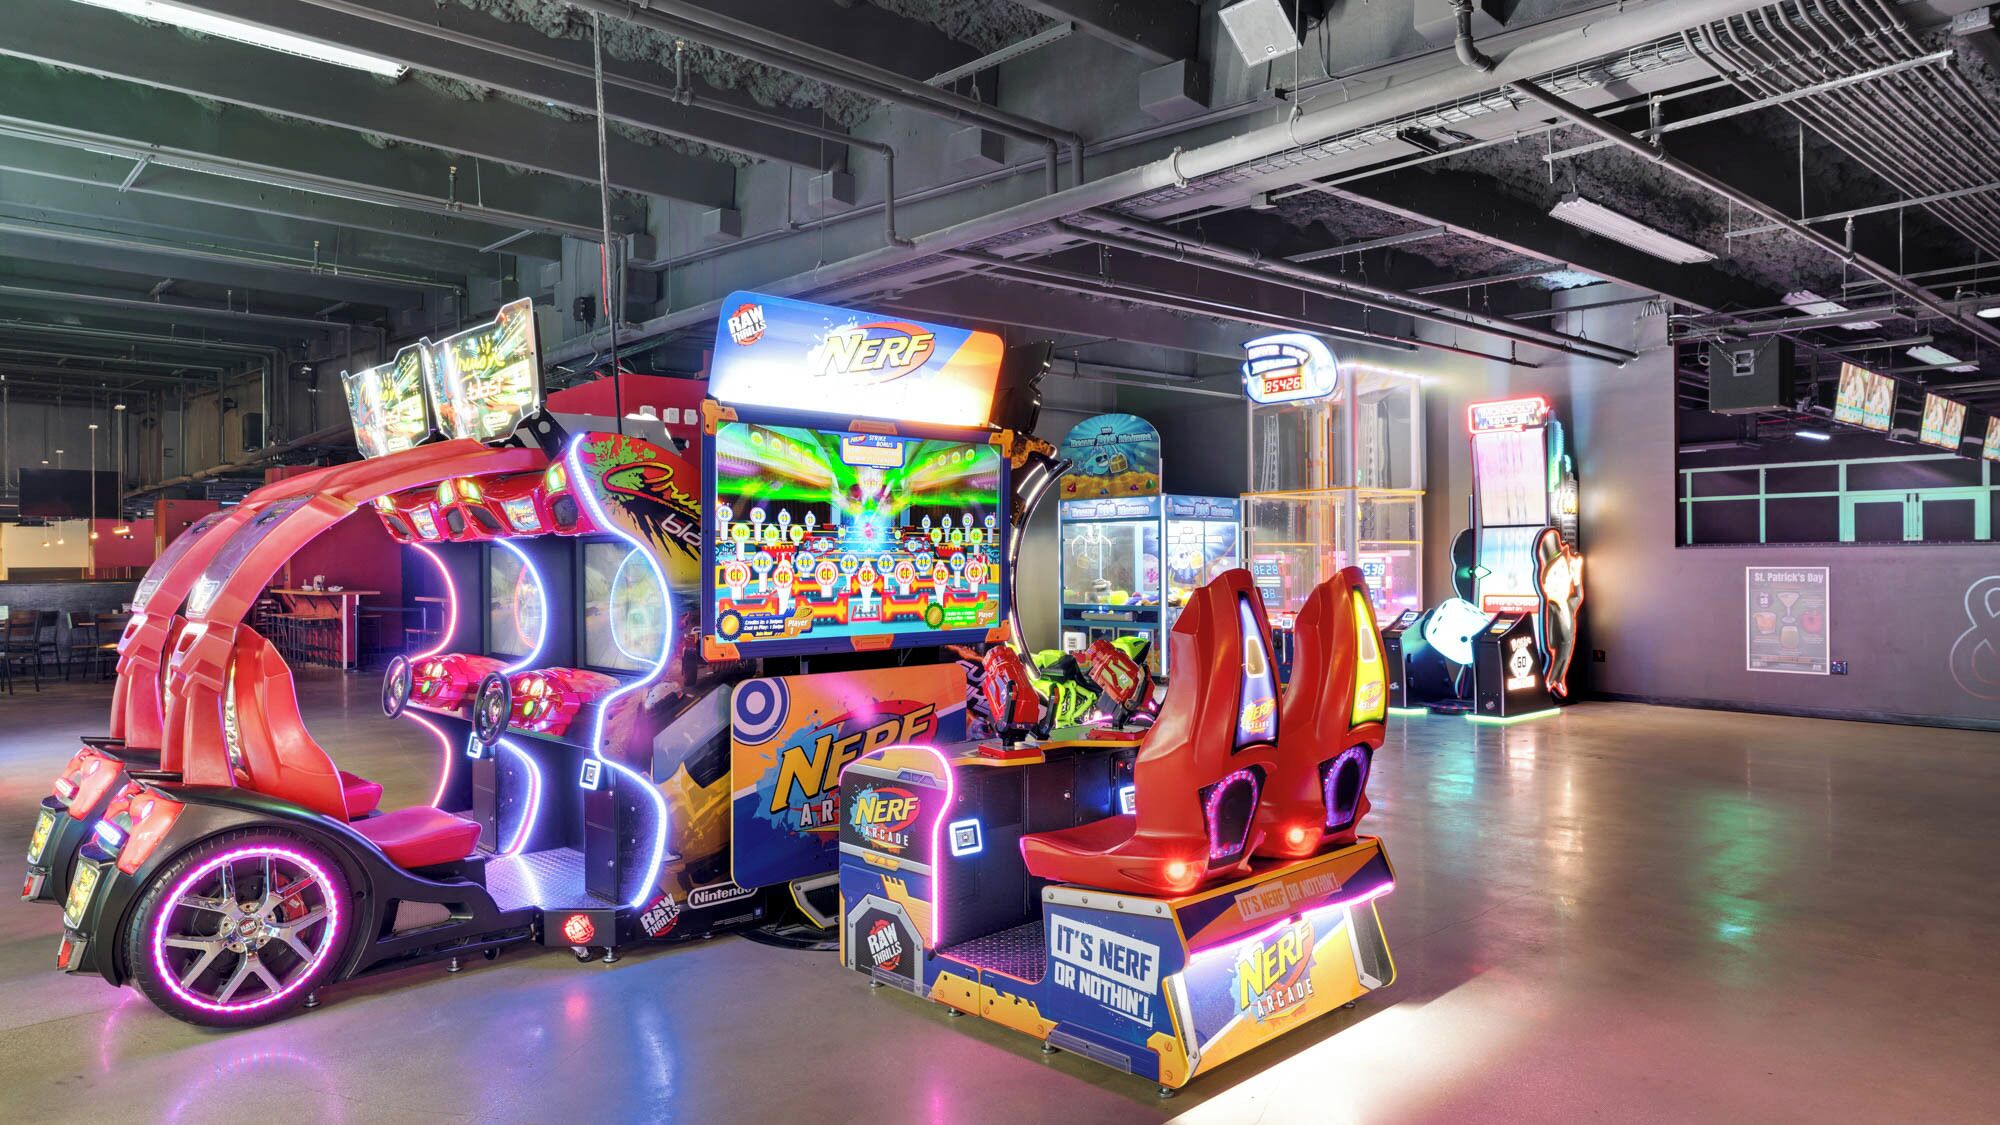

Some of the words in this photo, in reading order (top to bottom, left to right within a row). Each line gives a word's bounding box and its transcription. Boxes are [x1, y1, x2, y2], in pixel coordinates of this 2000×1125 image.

[728, 305, 763, 335] RAW
[732, 320, 767, 343] THRILLS
[814, 333, 935, 377] NERF
[1265, 377, 1300, 393] 85426
[1754, 572, 1765, 582] St.
[1767, 572, 1806, 582] Patrick's
[1807, 572, 1824, 583] Day
[787, 619, 807, 628] Player
[855, 796, 918, 825] NERF
[865, 826, 909, 846] ARCADE
[640, 893, 675, 930] RAW
[1240, 895, 1261, 917] IT'S
[1261, 888, 1285, 910] NERF
[1286, 883, 1302, 901] OR
[565, 915, 590, 937] RAW
[646, 904, 680, 936] THRILLS
[867, 922, 898, 955] RAW
[872, 941, 903, 965] THRILLS
[1057, 924, 1093, 962] IT'S
[1099, 938, 1153, 982] NERF
[1240, 919, 1311, 1011] NERF
[1054, 961, 1075, 990] OR
[1079, 970, 1149, 1020] NOTHIN'!
[1257, 978, 1313, 1017] ARCADE
